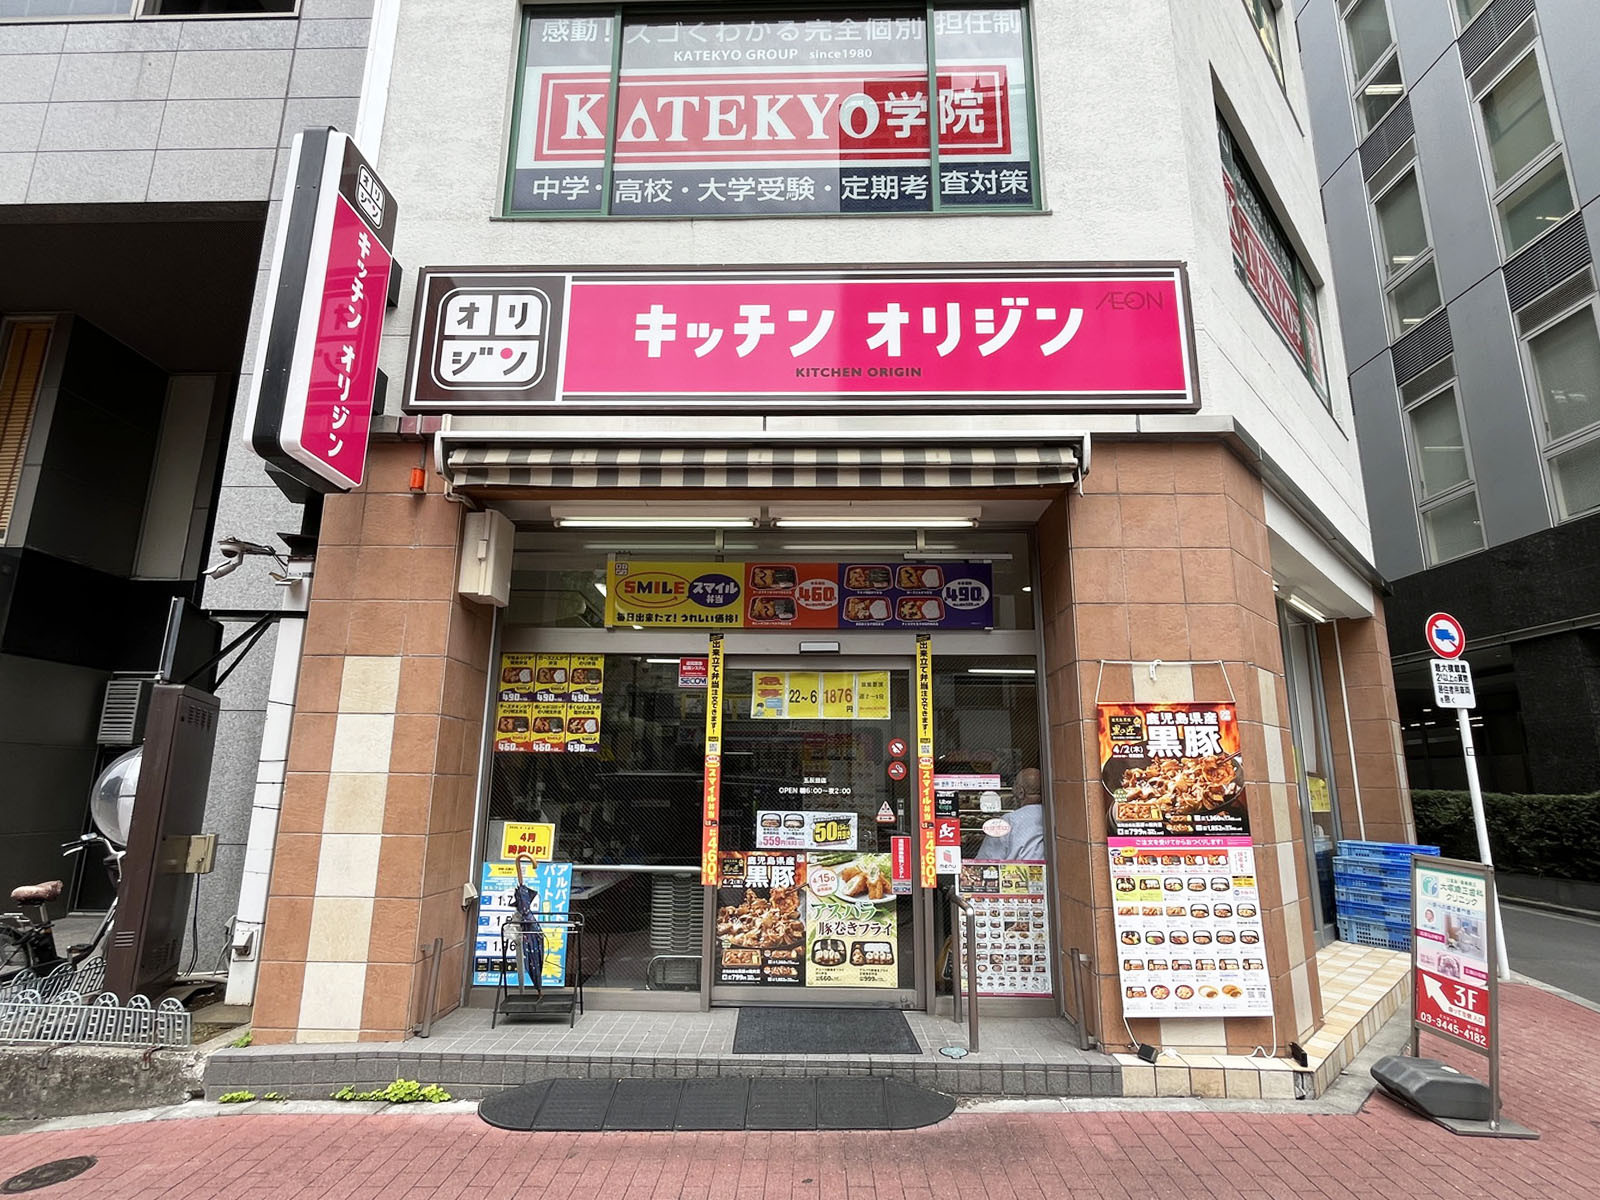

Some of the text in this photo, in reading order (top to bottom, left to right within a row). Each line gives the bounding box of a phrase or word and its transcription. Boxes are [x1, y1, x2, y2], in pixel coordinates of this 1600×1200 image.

[673, 46, 873, 62] KATEKYO GROUP since1980
[634, 296, 1085, 359] キッチン オリジン
[327, 230, 372, 457] キッチン オリジン
[795, 367, 922, 378] KITCHEN ORIGIN
[624, 580, 686, 595] SMILE
[692, 581, 738, 594] スマイル
[706, 594, 724, 604] 弁当
[680, 677, 707, 685] SECOM
[824, 688, 853, 704] 1876
[846, 705, 854, 713] 円
[1145, 711, 1219, 725] 鹿児島県産
[1146, 725, 1222, 758] 黒豚
[519, 832, 537, 843] 4月
[814, 821, 838, 842] 50
[744, 865, 796, 889] 黒豚
[810, 902, 877, 922] アスパラ
[818, 921, 893, 936] 豚巻きフライ
[1452, 984, 1479, 1011] 3F
[1420, 1011, 1487, 1046] 03-3445-4182
